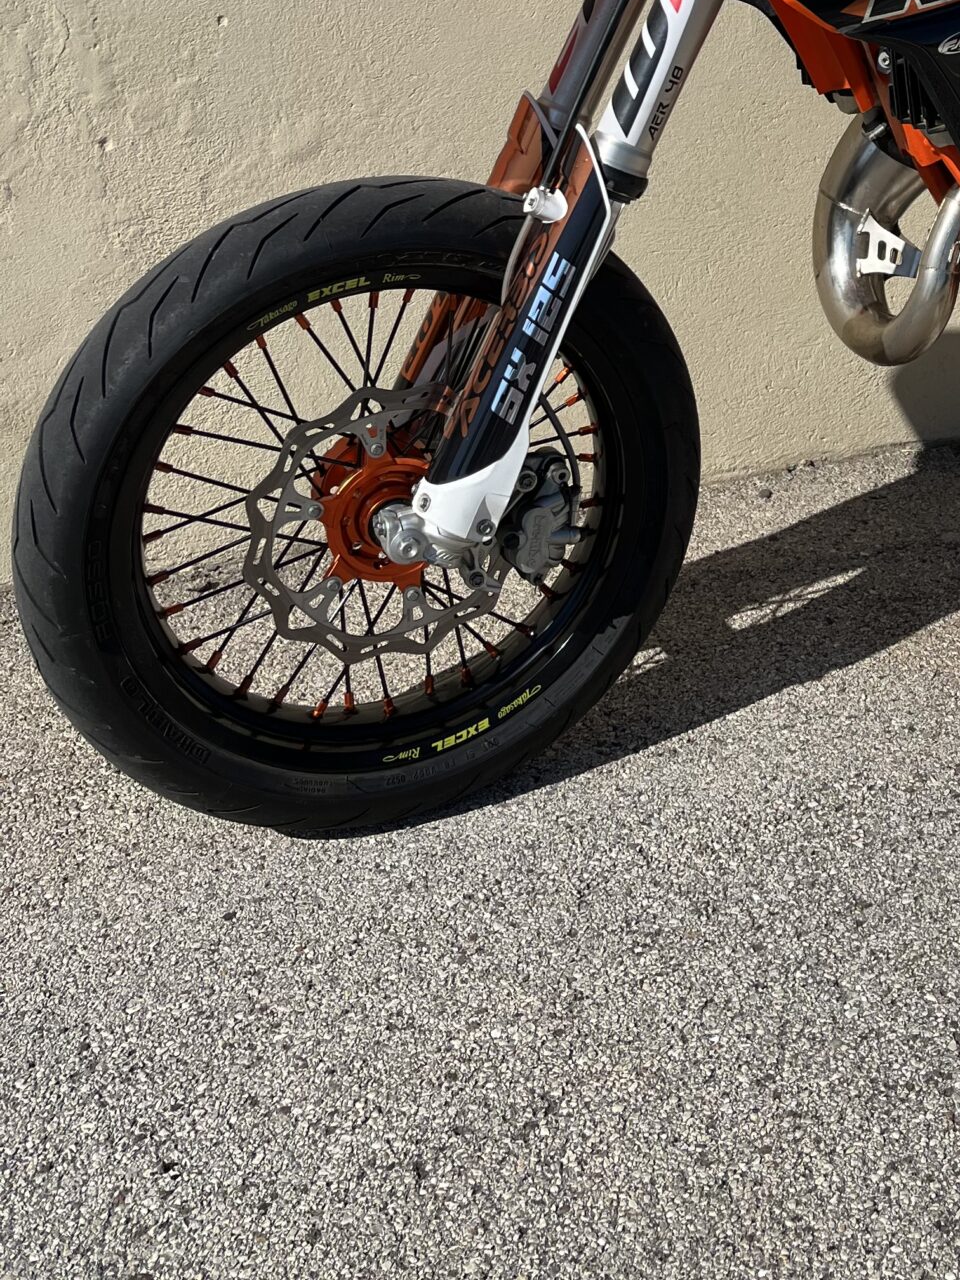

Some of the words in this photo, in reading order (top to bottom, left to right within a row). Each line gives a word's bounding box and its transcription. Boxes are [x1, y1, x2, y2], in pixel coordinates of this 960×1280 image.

[647, 101, 671, 141] AER
[664, 65, 685, 94] 48
[246, 299, 300, 332] Takasago
[306, 276, 372, 303] EXCEL
[490, 346, 538, 426] SX
[521, 250, 577, 347] 125
[497, 684, 542, 720] Takasago
[381, 746, 421, 763] Rim
[431, 716, 492, 753] EXCEL
